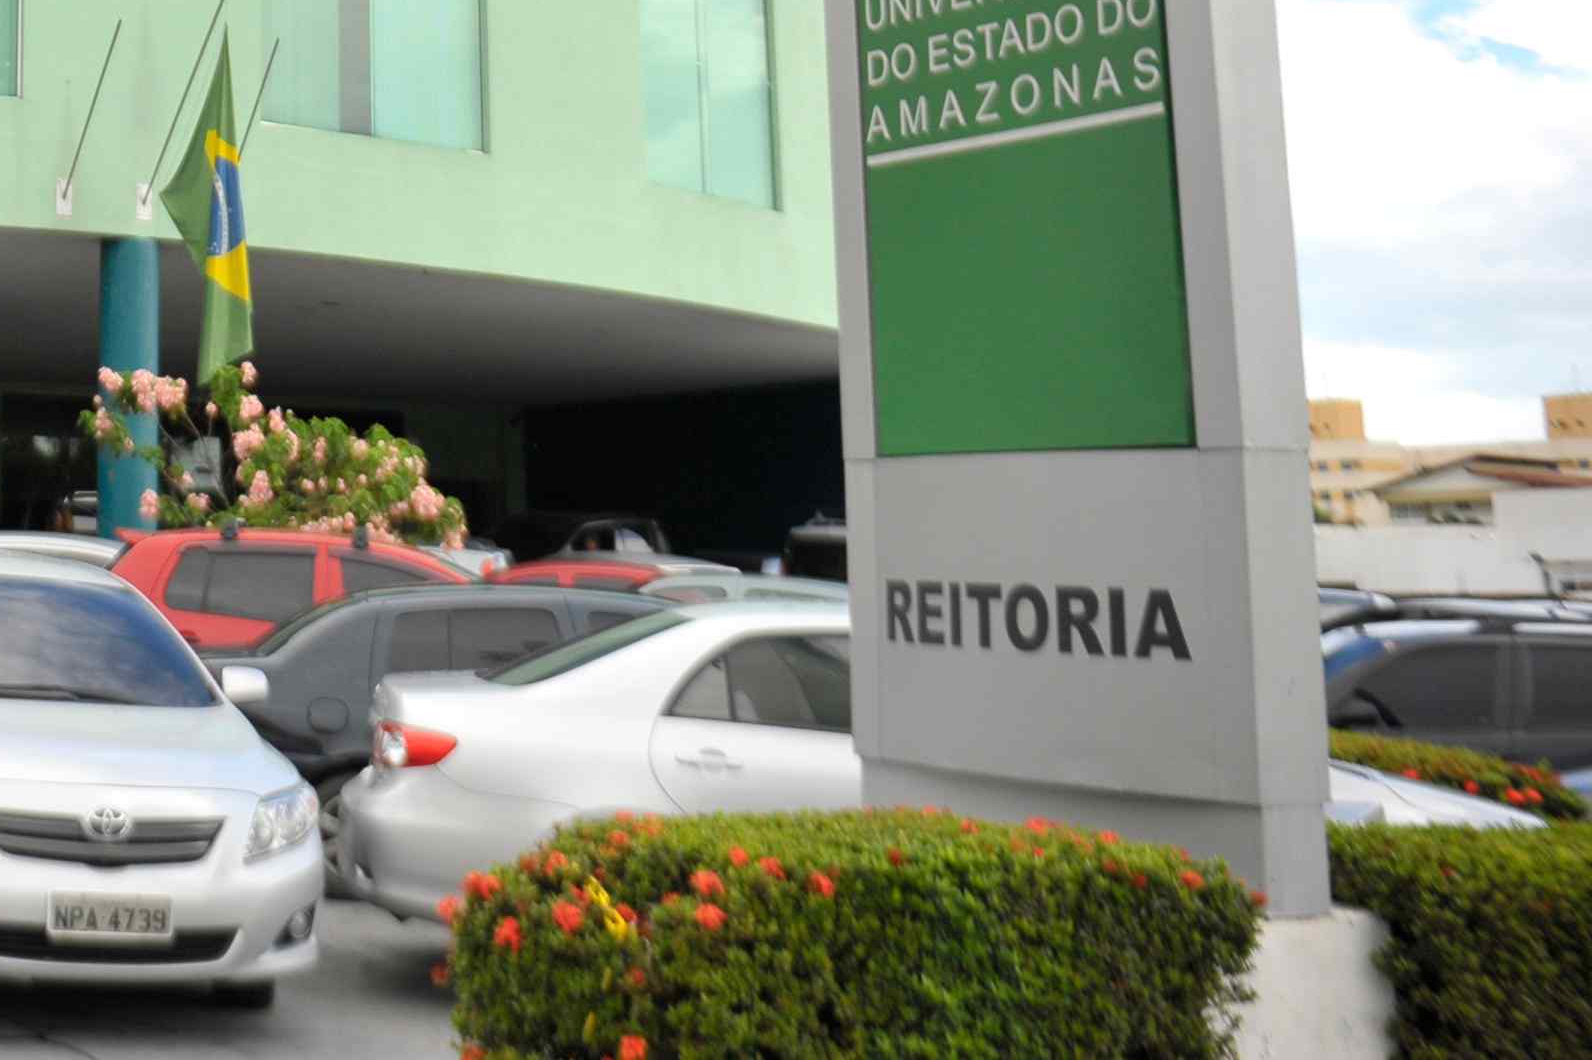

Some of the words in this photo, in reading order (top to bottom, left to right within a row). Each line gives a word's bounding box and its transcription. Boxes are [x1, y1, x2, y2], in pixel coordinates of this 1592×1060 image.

[866, 43, 917, 86] DO
[927, 4, 1084, 73] ESTADO
[866, 47, 1161, 144] AMAZONAS
[885, 579, 1193, 662] REITORIA
[55, 905, 98, 930] NPA
[108, 907, 166, 933] 4739
